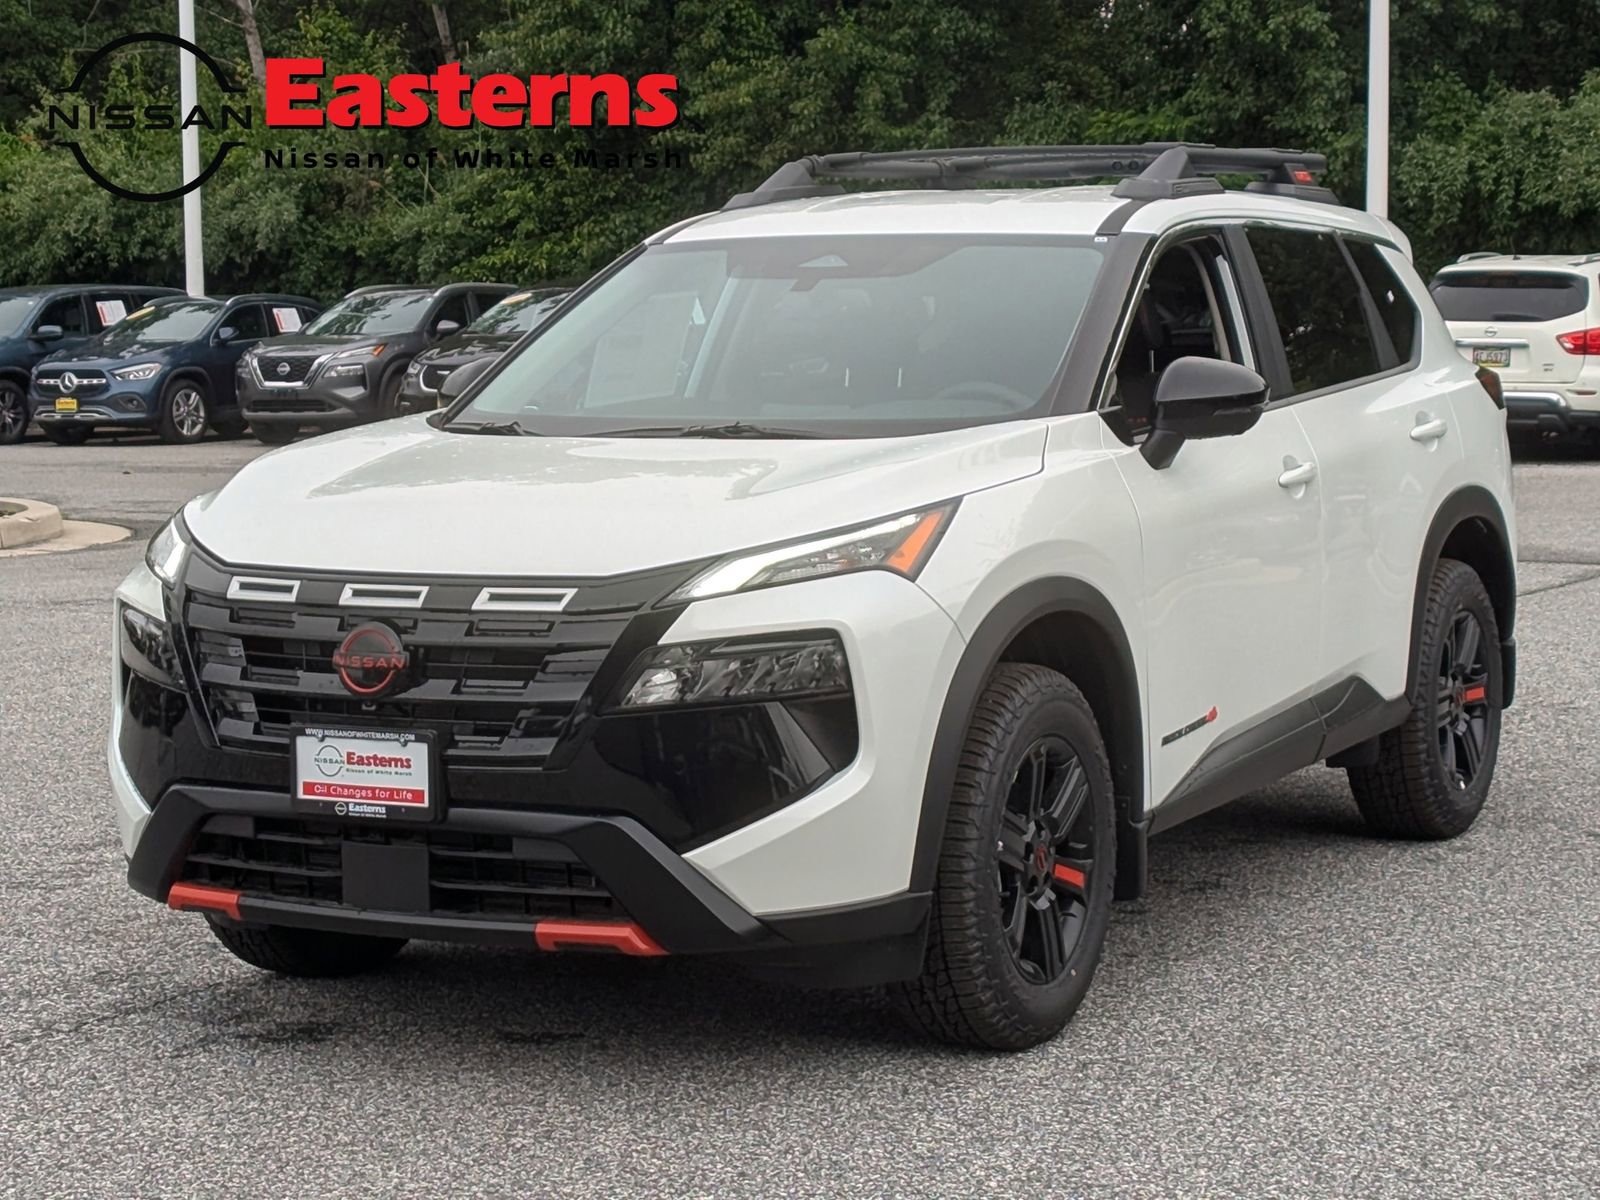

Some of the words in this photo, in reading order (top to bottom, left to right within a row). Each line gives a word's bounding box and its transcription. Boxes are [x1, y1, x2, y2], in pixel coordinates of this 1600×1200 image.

[335, 654, 406, 669] NISSAN
[314, 757, 345, 765] NISSAN
[346, 751, 412, 769] Easterns
[314, 784, 328, 793] Oil
[330, 785, 372, 798] Changes
[375, 788, 390, 798] for
[393, 790, 413, 800] Life
[348, 802, 387, 814] Easterns
